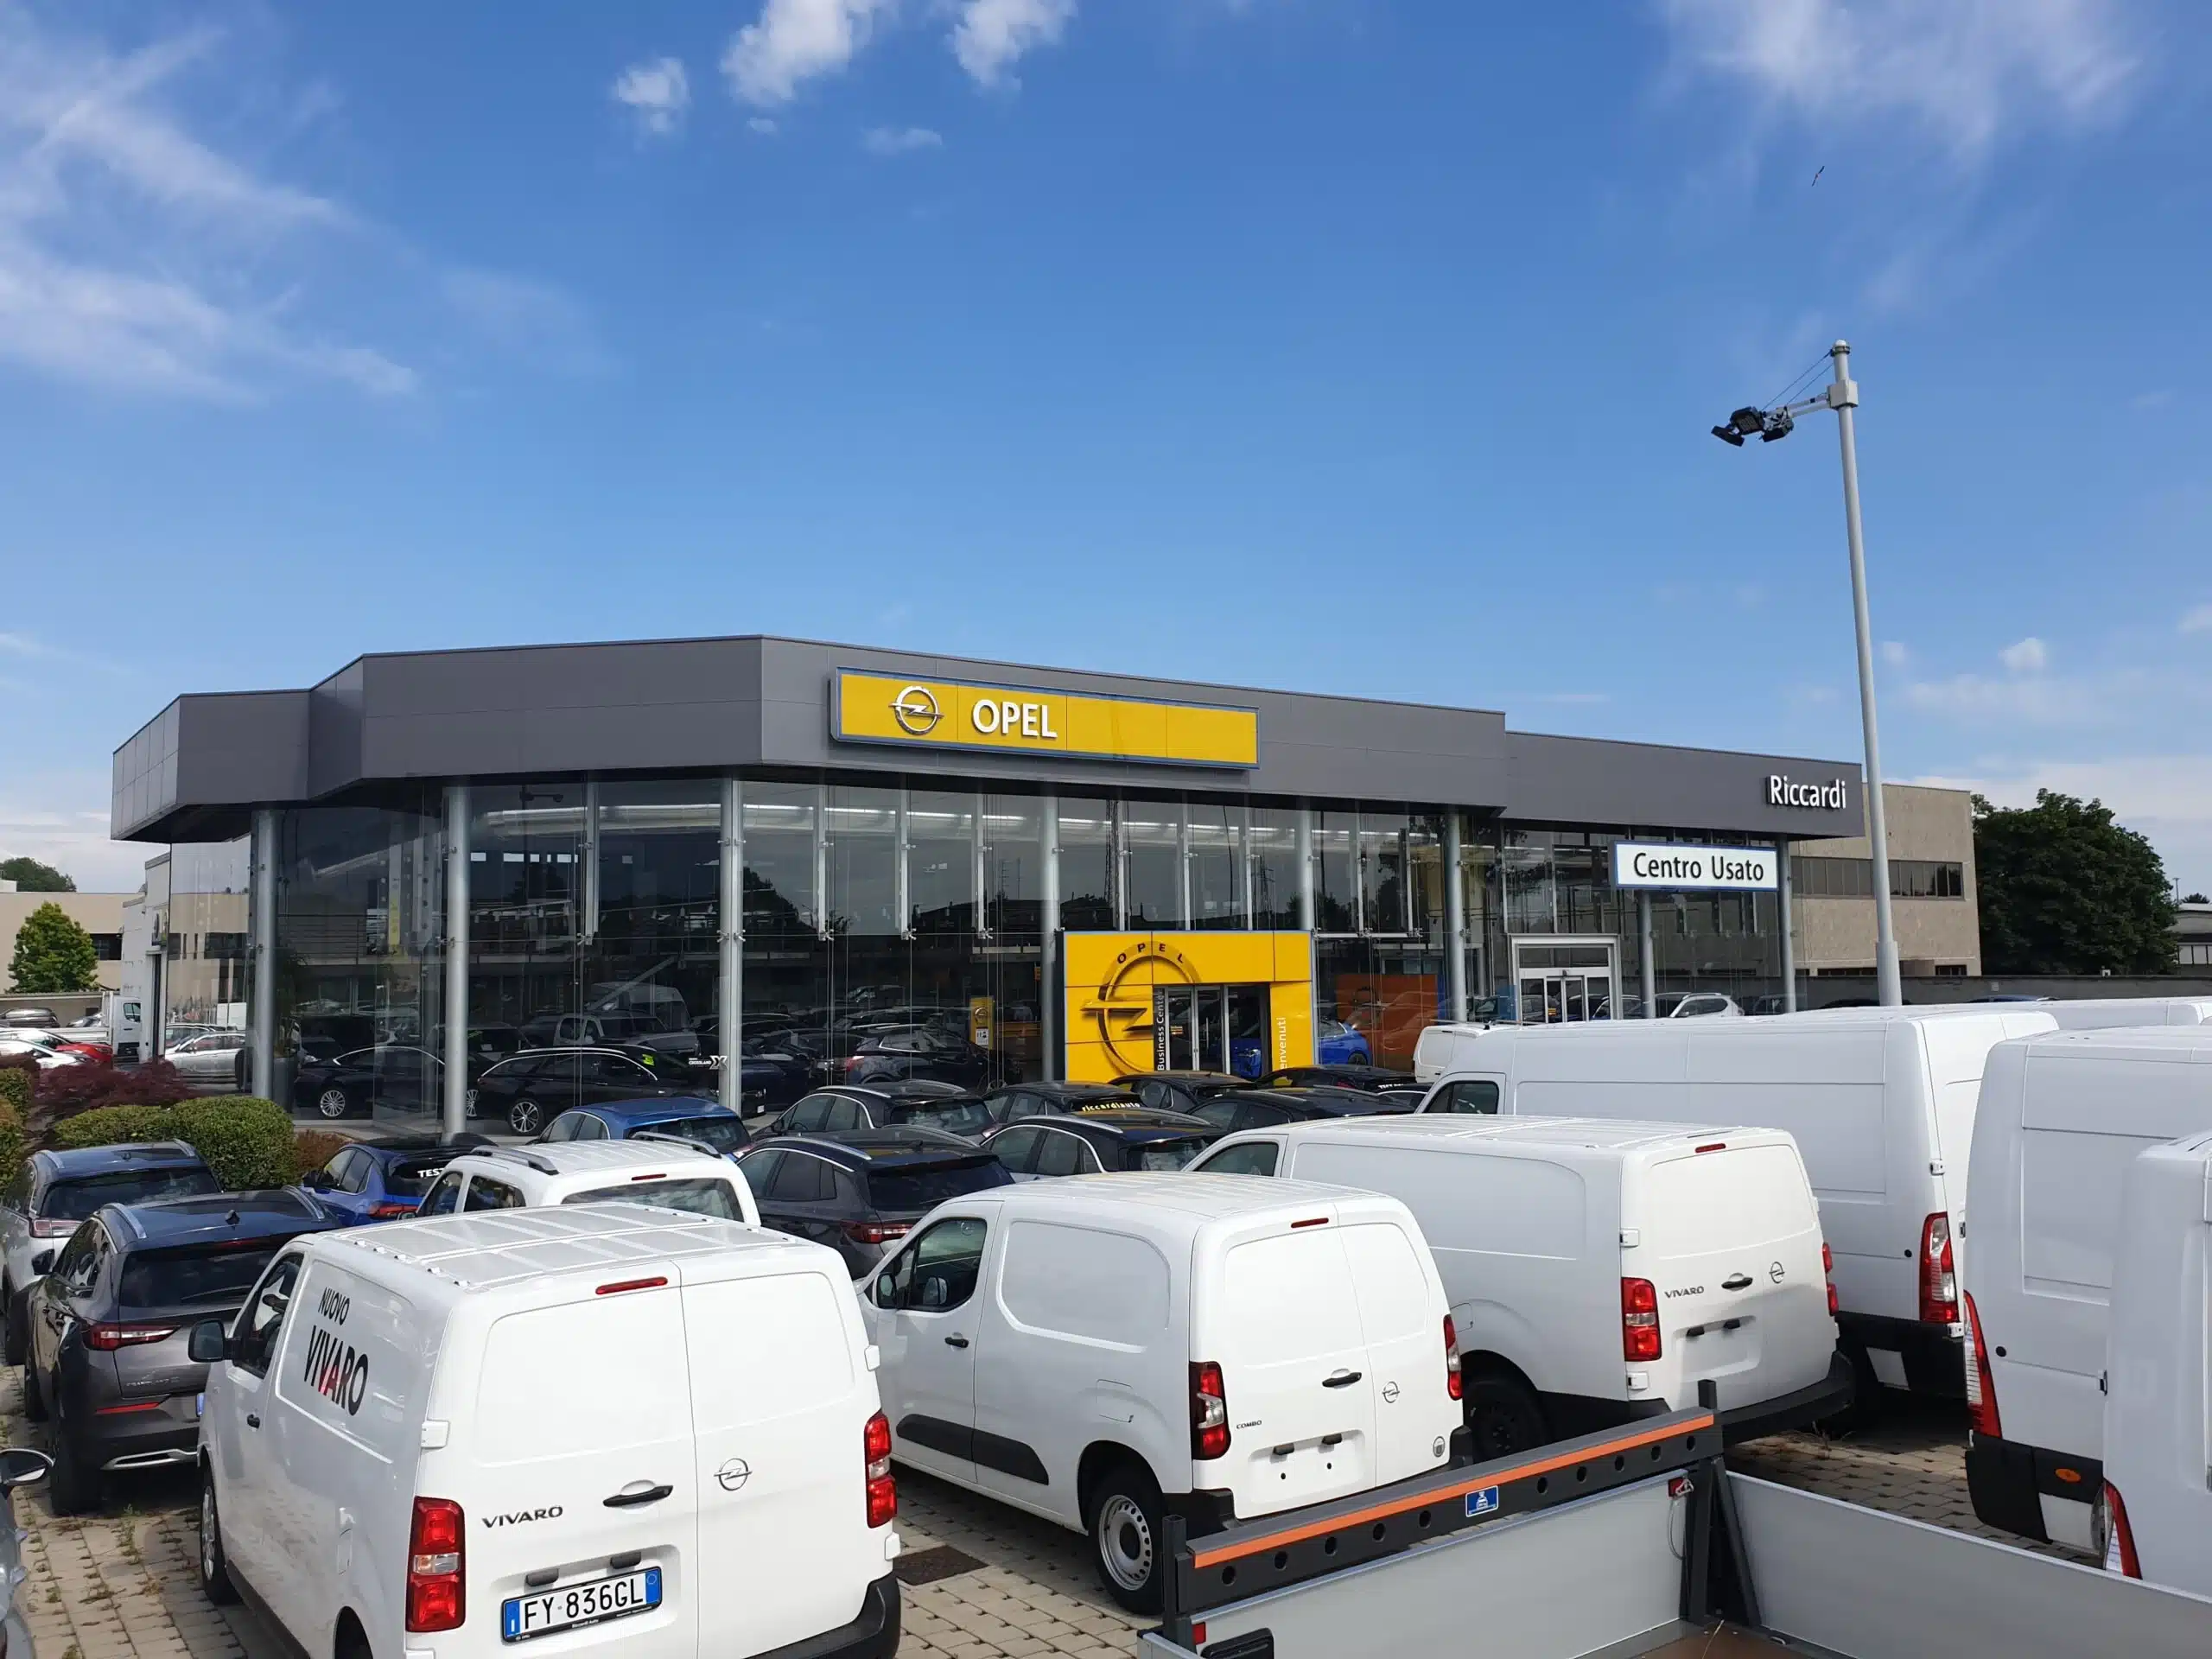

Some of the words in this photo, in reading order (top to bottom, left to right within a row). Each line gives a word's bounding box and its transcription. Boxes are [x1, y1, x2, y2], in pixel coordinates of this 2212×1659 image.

[971, 698, 1058, 739] OPEL
[1770, 774, 1847, 810] Riccardi
[1633, 852, 1702, 879] Centro
[1711, 855, 1764, 881] Usato
[1116, 943, 1184, 964] OPEL
[1156, 1026, 1166, 1071] Business
[1275, 1016, 1287, 1070] envenuti
[1081, 1102, 1141, 1112] riccardiauto
[317, 1287, 351, 1326] NUOVO
[1664, 1286, 1705, 1298] VIVARO
[303, 1325, 369, 1417] VIVARO
[1236, 1420, 1262, 1429] COMBO
[481, 1506, 563, 1529] VIVARO
[524, 1596, 555, 1630] FY
[566, 1578, 644, 1618] 836GL
